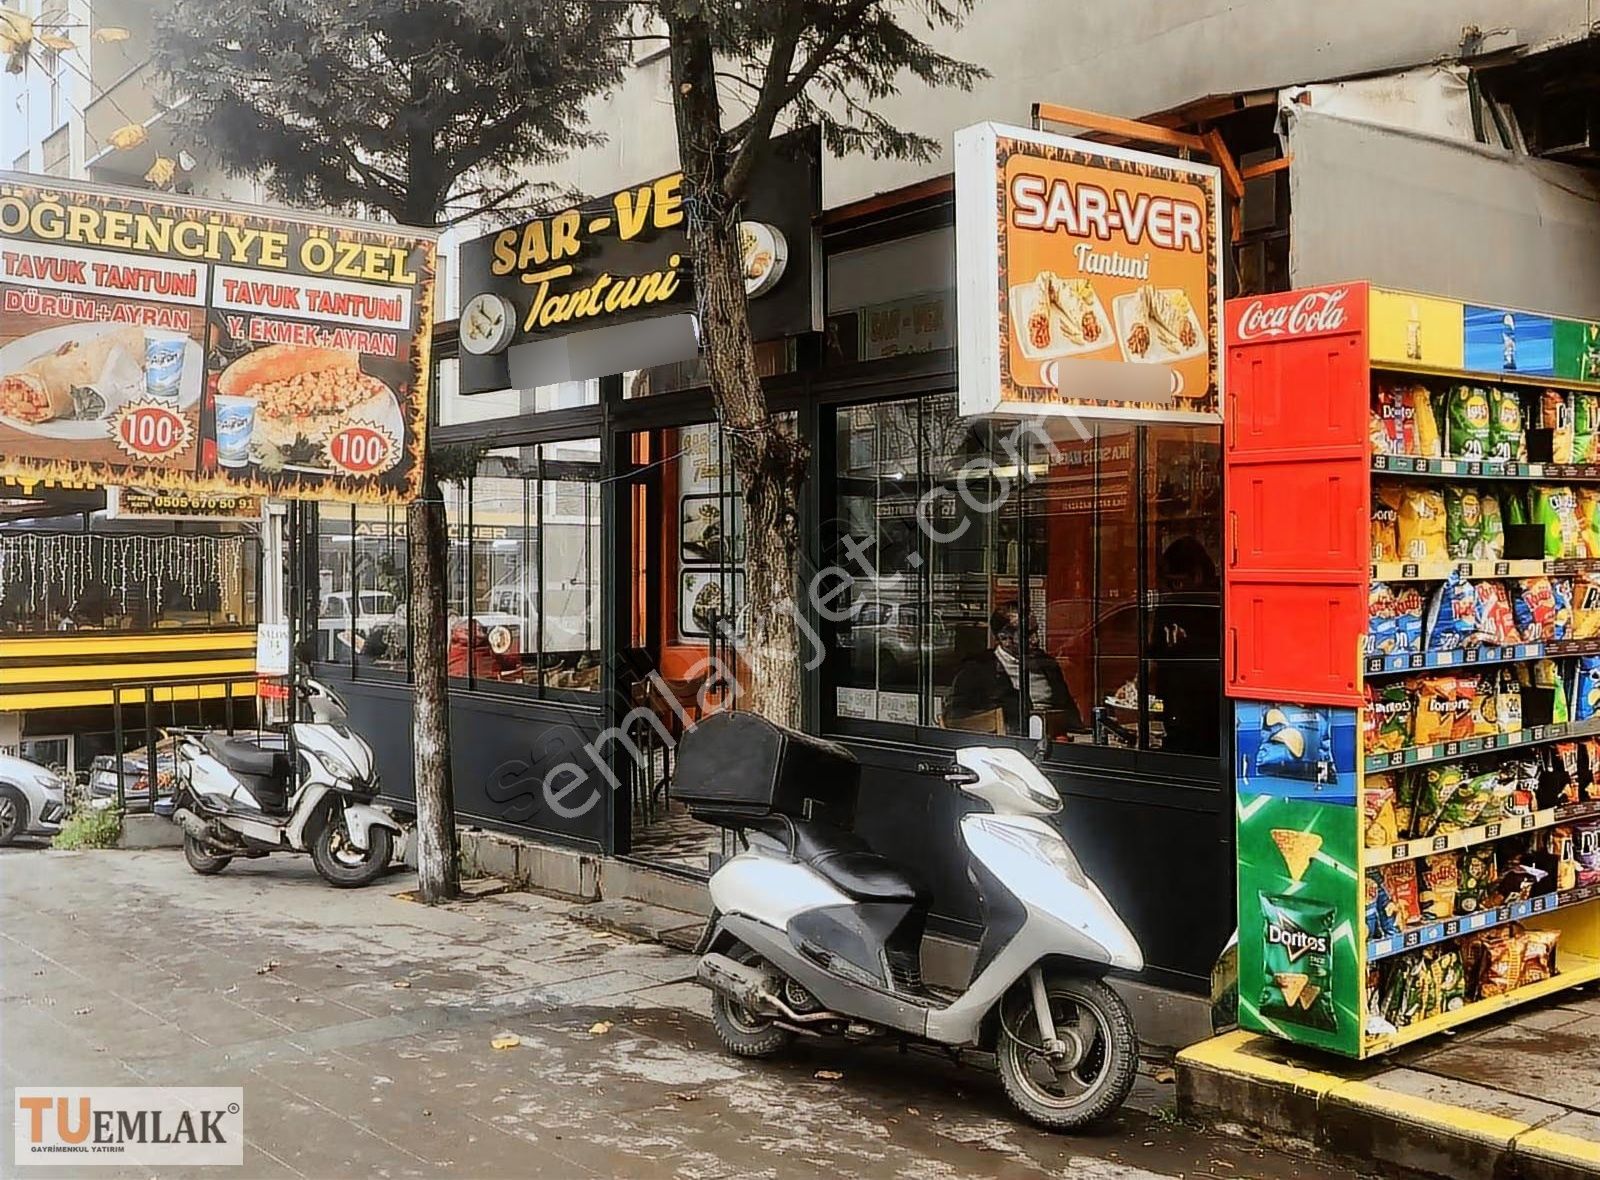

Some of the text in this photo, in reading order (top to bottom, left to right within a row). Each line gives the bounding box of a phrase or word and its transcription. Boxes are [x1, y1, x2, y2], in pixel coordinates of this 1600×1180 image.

[1010, 173, 1203, 253] SAR-VER
[0, 192, 417, 285] ÖĞRENCİYE ÖZEL
[2, 250, 197, 298] TAVUK TANTUNİ
[1073, 242, 1150, 280] Tantuni
[4, 289, 191, 331] DÜRÜM+AYRAN
[223, 278, 403, 322] TAVUK TANTUNİ
[521, 254, 681, 333] Tantuni
[227, 315, 398, 357] Y. EKMEK+AYRAN
[1268, 924, 1327, 953] Doritos
